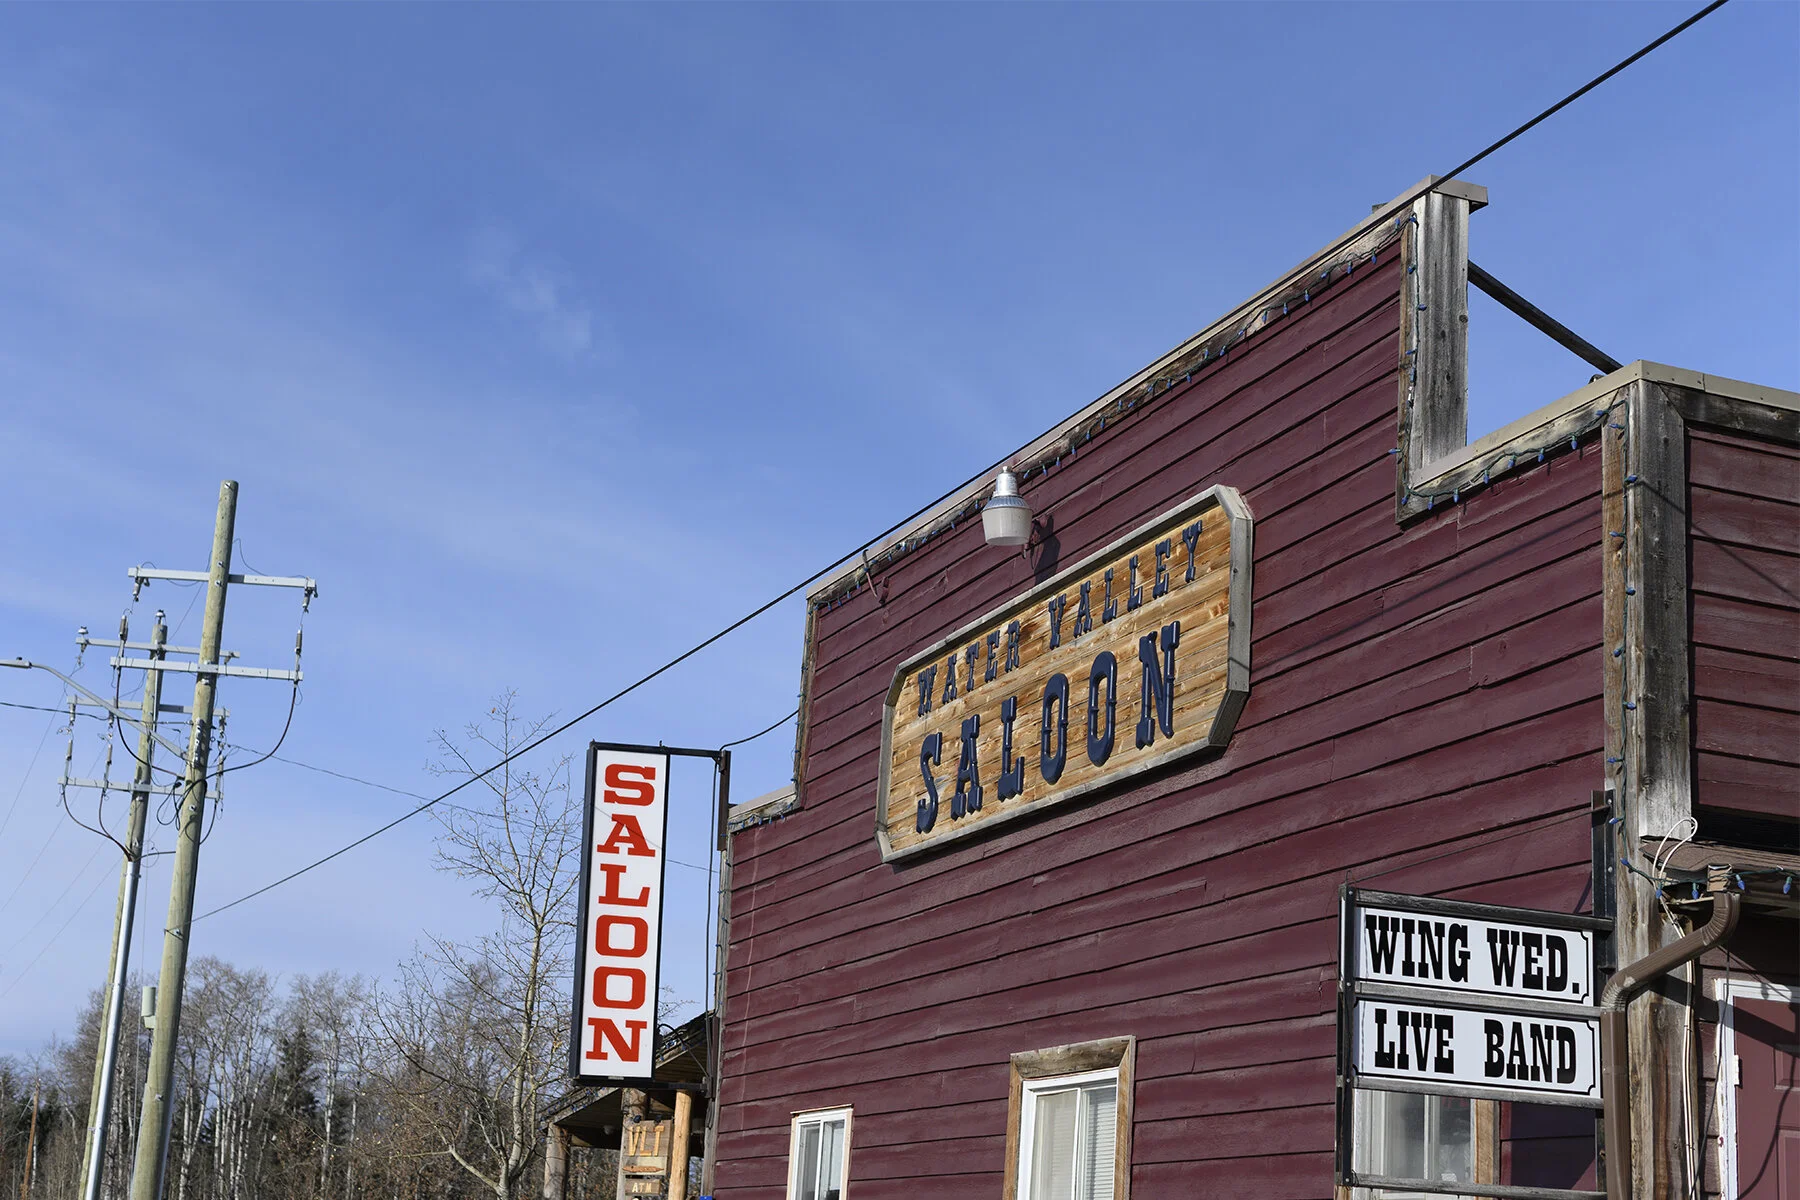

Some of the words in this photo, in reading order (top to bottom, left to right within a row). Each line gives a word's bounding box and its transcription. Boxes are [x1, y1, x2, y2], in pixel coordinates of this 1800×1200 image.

[918, 622, 1021, 717] WATER
[1048, 520, 1202, 650] VALLEY
[917, 620, 1181, 834] SALOON
[585, 763, 656, 1063] SALOON
[1365, 914, 1471, 983] WING
[1486, 928, 1580, 994] WED.
[1374, 1008, 1455, 1074] LIVE
[1484, 1018, 1576, 1084] BAND
[628, 1125, 664, 1157] VLT
[632, 1182, 652, 1193] ATM
